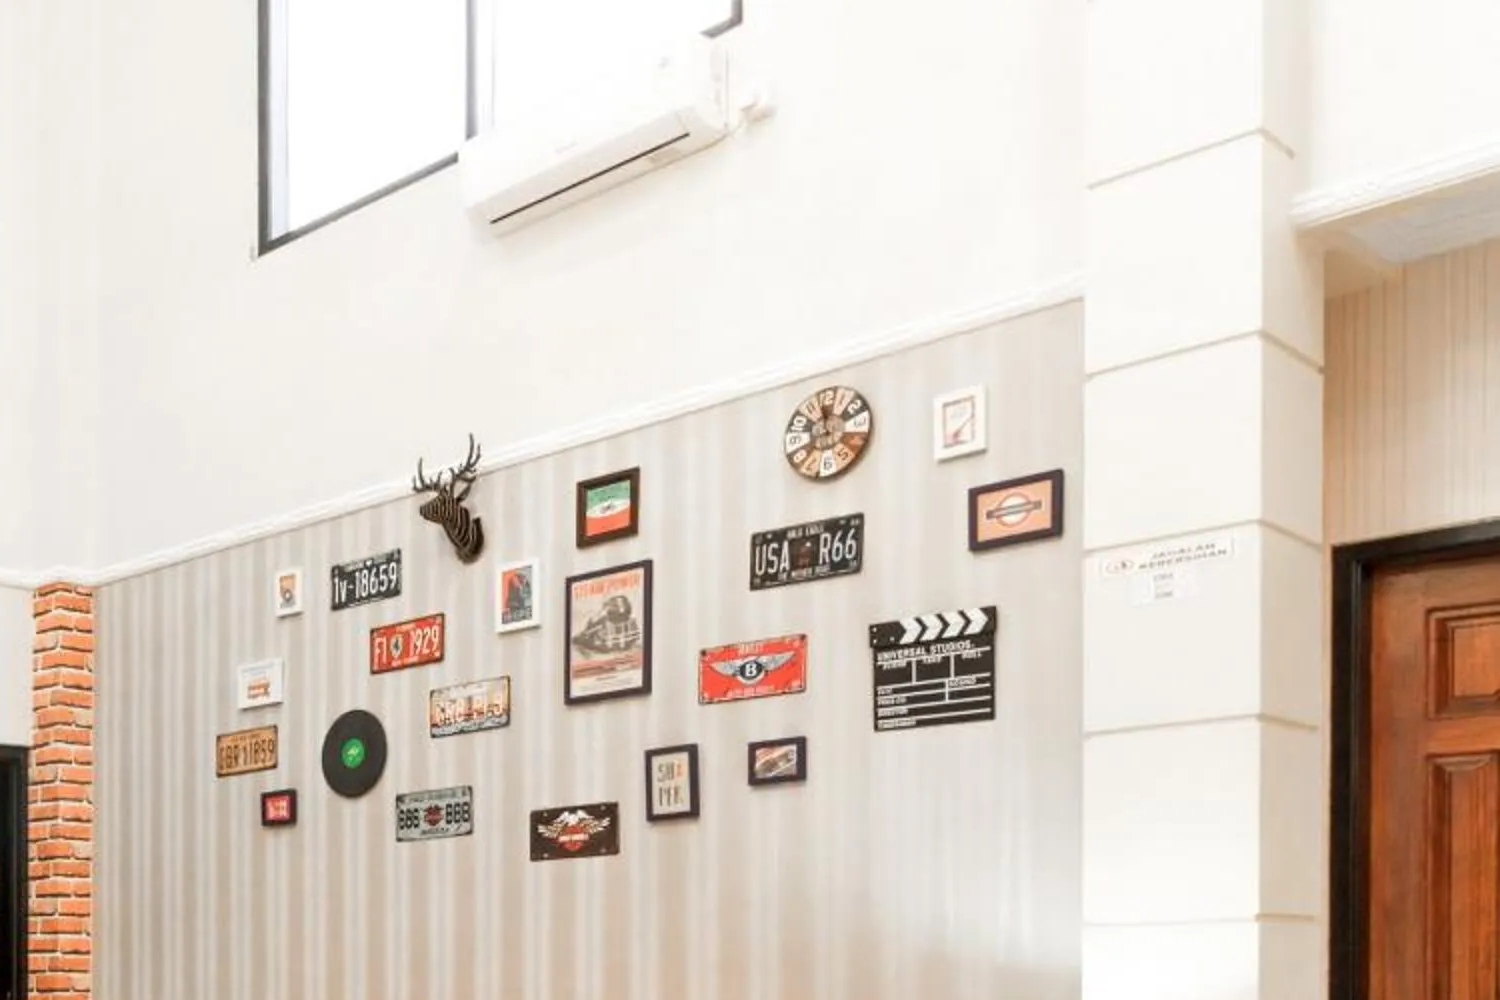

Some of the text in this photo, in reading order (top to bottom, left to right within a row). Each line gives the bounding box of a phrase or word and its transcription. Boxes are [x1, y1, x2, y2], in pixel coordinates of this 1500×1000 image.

[755, 540, 790, 576] USA
[819, 527, 857, 565] R66
[408, 625, 440, 658] 1929
[876, 646, 926, 662] UNIVERSAL
[744, 662, 758, 678] B
